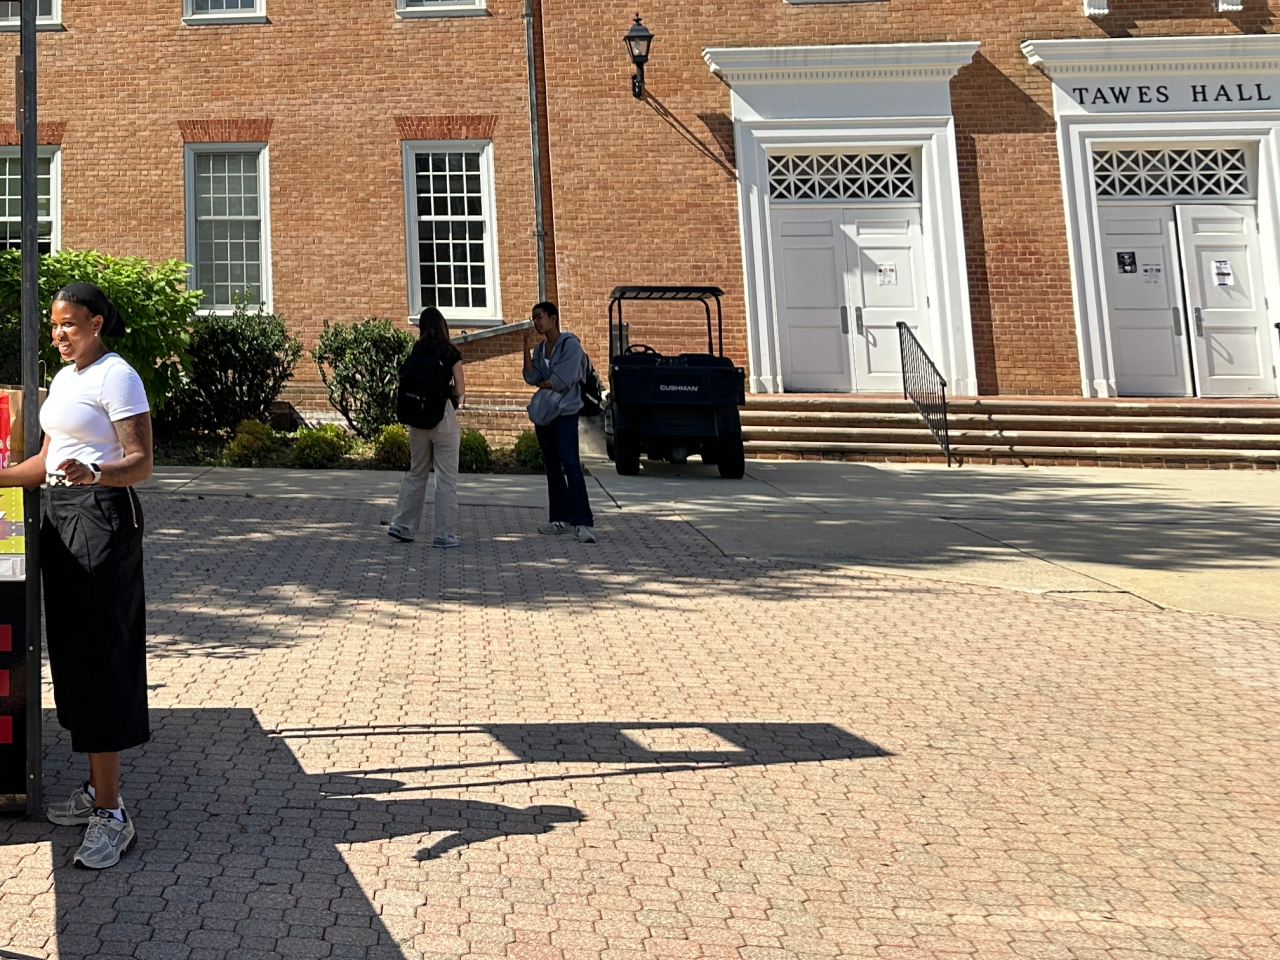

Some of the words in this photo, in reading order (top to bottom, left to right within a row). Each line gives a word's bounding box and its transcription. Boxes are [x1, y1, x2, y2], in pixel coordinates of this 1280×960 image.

[1073, 86, 1170, 105] TAWES
[1191, 84, 1271, 102] HALL
[660, 384, 698, 392] CUSHMAN
